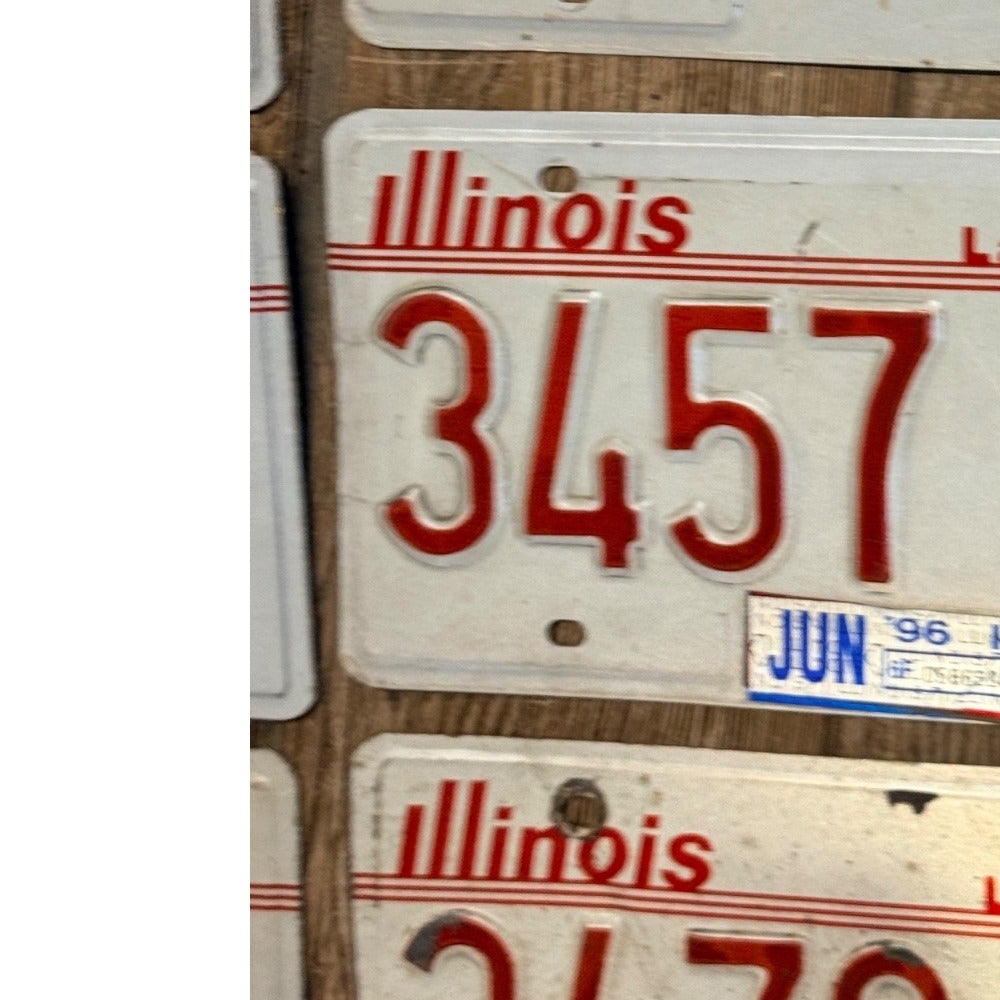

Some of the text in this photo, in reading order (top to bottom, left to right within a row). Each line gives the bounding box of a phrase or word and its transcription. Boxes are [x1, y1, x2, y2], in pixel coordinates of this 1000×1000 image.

[370, 150, 693, 254] Illinois
[377, 292, 935, 584] 3457
[766, 608, 865, 686] JUN
[396, 779, 715, 892] Illinois
